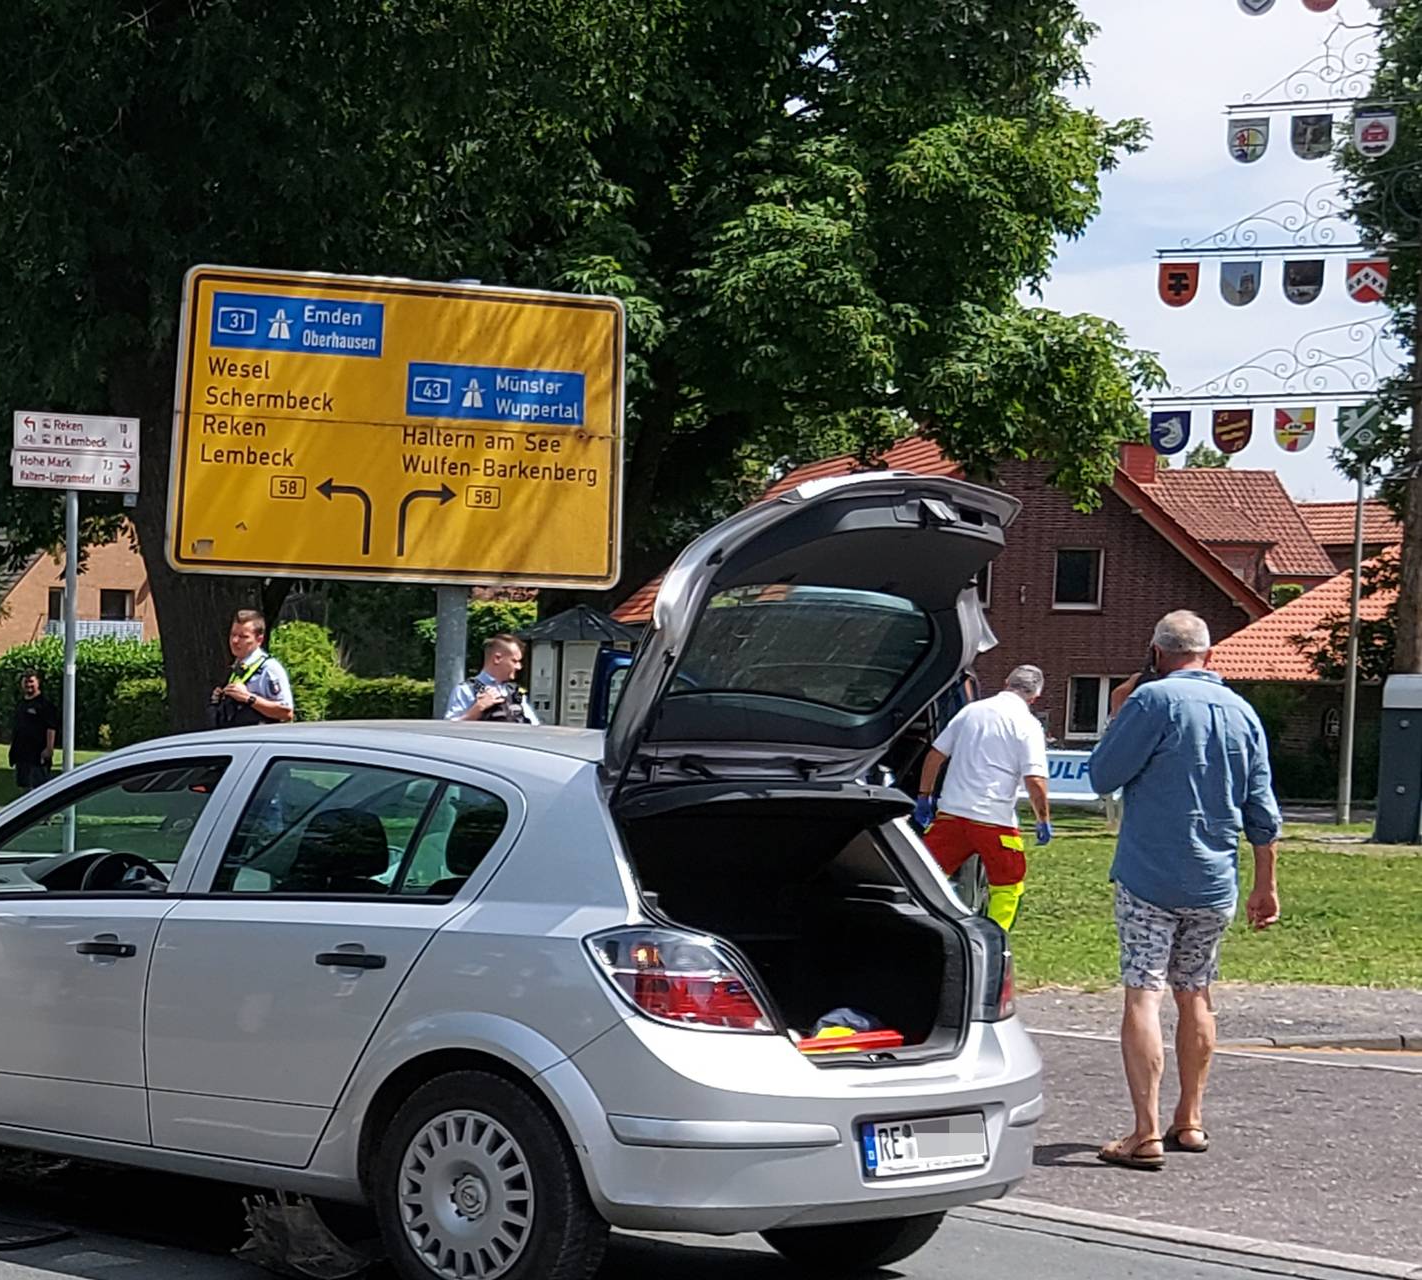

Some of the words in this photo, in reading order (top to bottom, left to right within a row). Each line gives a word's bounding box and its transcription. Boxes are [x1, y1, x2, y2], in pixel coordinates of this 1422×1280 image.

[228, 312, 247, 330] 31
[303, 305, 362, 327] Emden
[302, 329, 377, 352] Oberhausen
[208, 356, 271, 381] Wesel
[422, 382, 442, 399] 43
[495, 374, 563, 395] Münster
[205, 385, 334, 413] Schermbeck
[495, 397, 579, 420] Wuppertal
[54, 419, 84, 432] Reken
[202, 415, 267, 438] Reken
[65, 437, 108, 448] Lembeck
[402, 426, 476, 451] Haltern
[483, 433, 515, 453] am
[523, 430, 562, 454] See
[20, 455, 44, 467] Hohe
[47, 455, 72, 468] Mark
[200, 442, 295, 468] Lembeck
[401, 454, 599, 488] Wulfen-Barkenberg
[278, 478, 299, 497] 58
[473, 488, 493, 506] 58
[878, 1127, 903, 1161] RE
